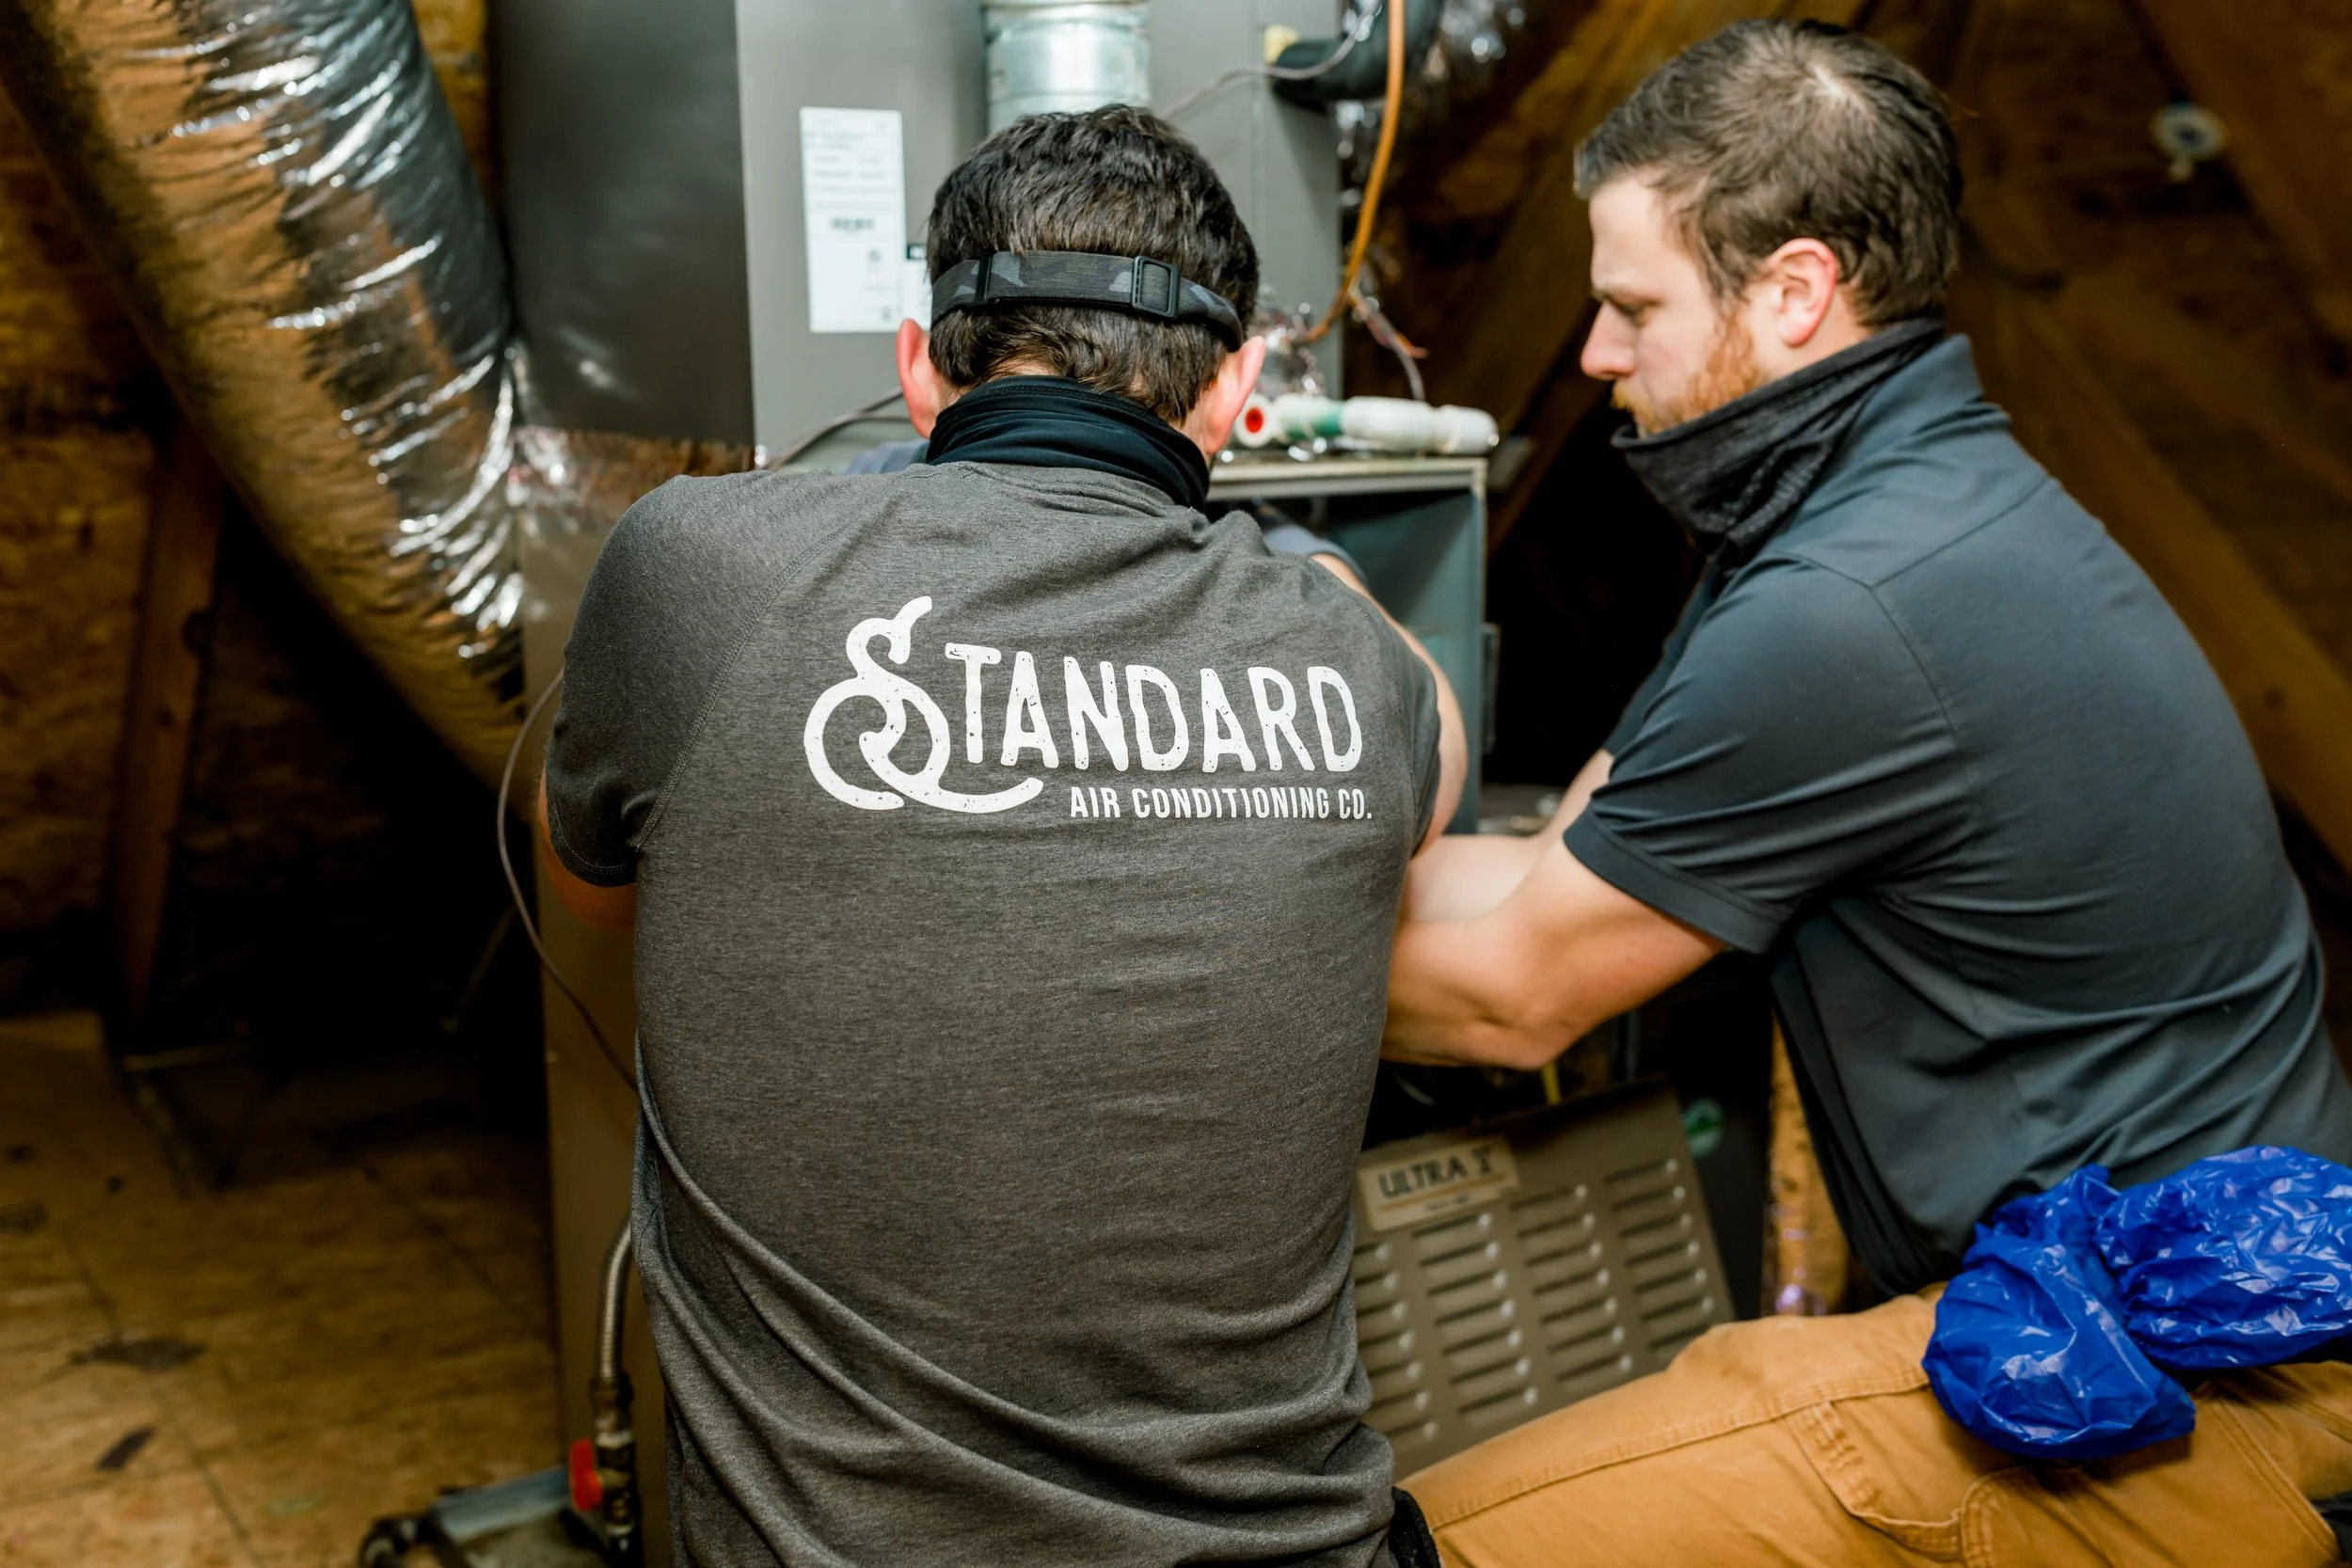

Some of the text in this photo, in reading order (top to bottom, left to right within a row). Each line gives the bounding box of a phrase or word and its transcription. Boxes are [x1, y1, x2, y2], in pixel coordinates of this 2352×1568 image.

[803, 595, 1363, 814] STANDARD
[1071, 787, 1373, 820] AIR CONDITIONING CO.
[1378, 1155, 1467, 1198] ULTRA
